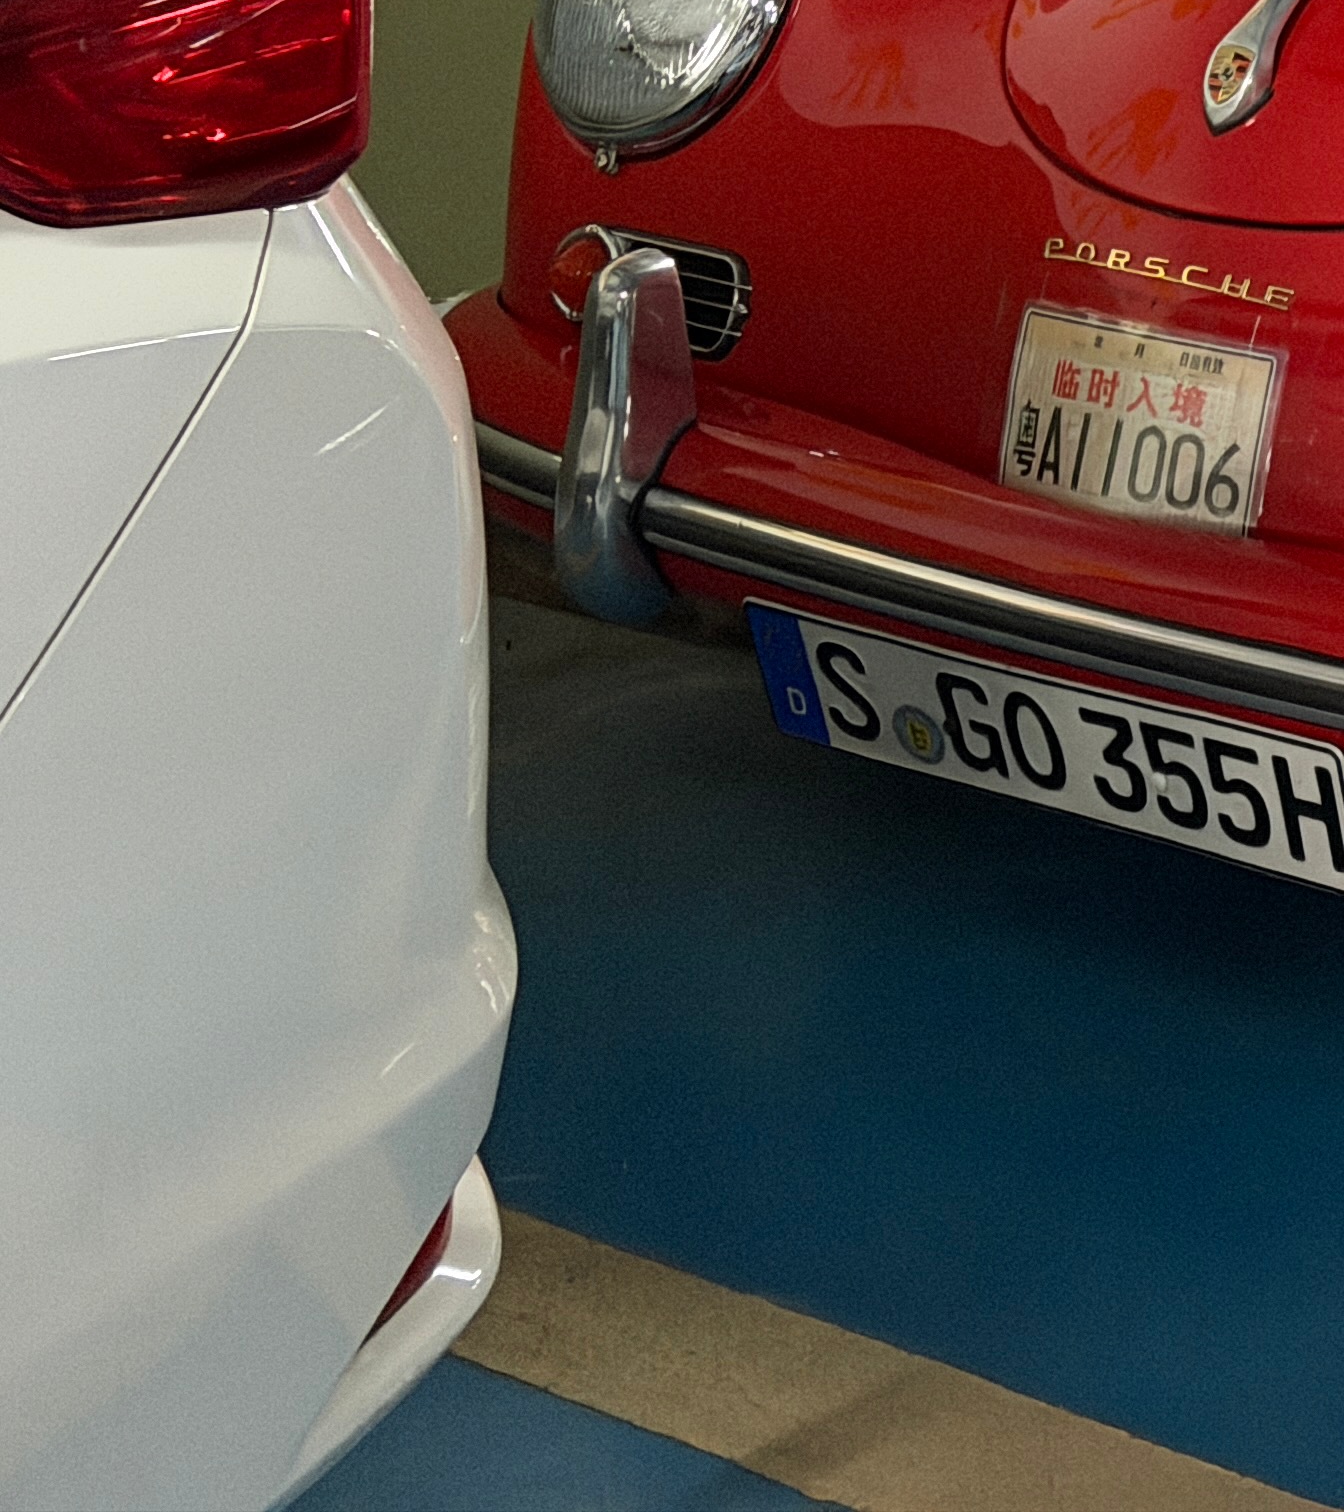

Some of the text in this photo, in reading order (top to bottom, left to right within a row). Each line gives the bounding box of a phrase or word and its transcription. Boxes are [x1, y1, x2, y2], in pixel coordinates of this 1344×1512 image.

[1044, 237, 1295, 311] PORSCHE
[787, 686, 807, 716] D
[815, 641, 881, 742] S
[935, 671, 1067, 791] GO
